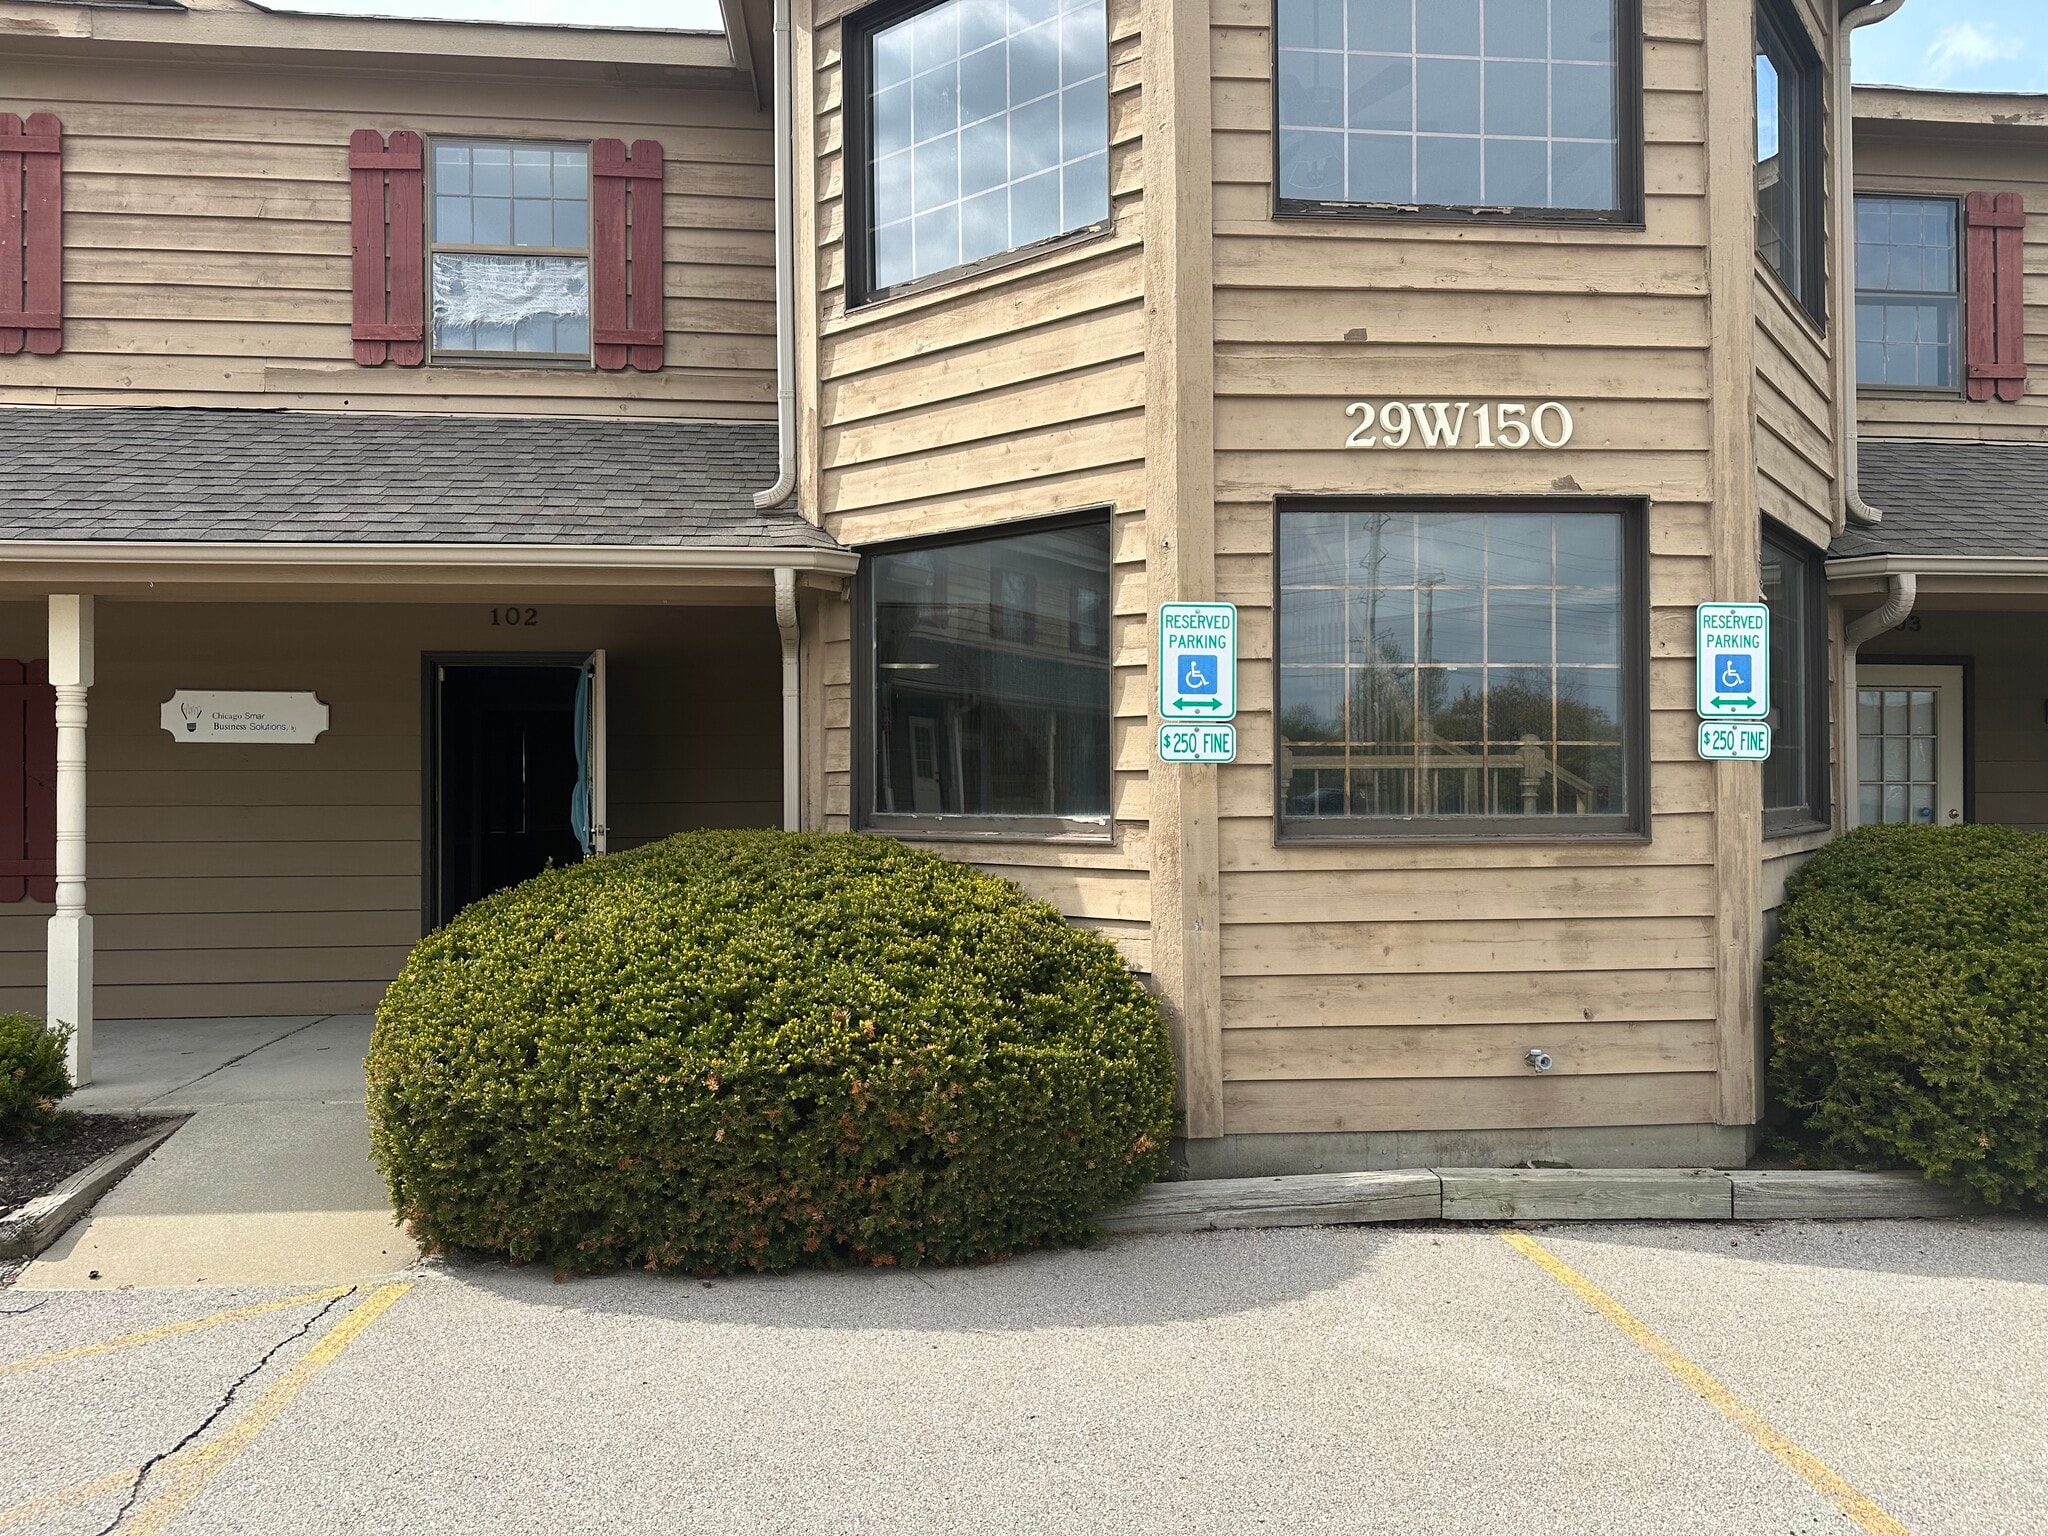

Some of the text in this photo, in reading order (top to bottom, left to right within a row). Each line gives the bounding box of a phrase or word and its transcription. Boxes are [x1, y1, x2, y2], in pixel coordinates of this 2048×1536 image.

[1345, 401, 1574, 449] 29W150
[490, 607, 538, 626] 102
[1165, 614, 1230, 629] RESERVED
[1703, 615, 1763, 629] RESERVED
[1169, 634, 1226, 649] PARKING
[1706, 634, 1760, 649] PARKING
[212, 712, 242, 721] Chicago
[213, 722, 247, 731] Business
[1163, 733, 1230, 753] $250 FINE
[1703, 730, 1765, 750] $250 FINE
